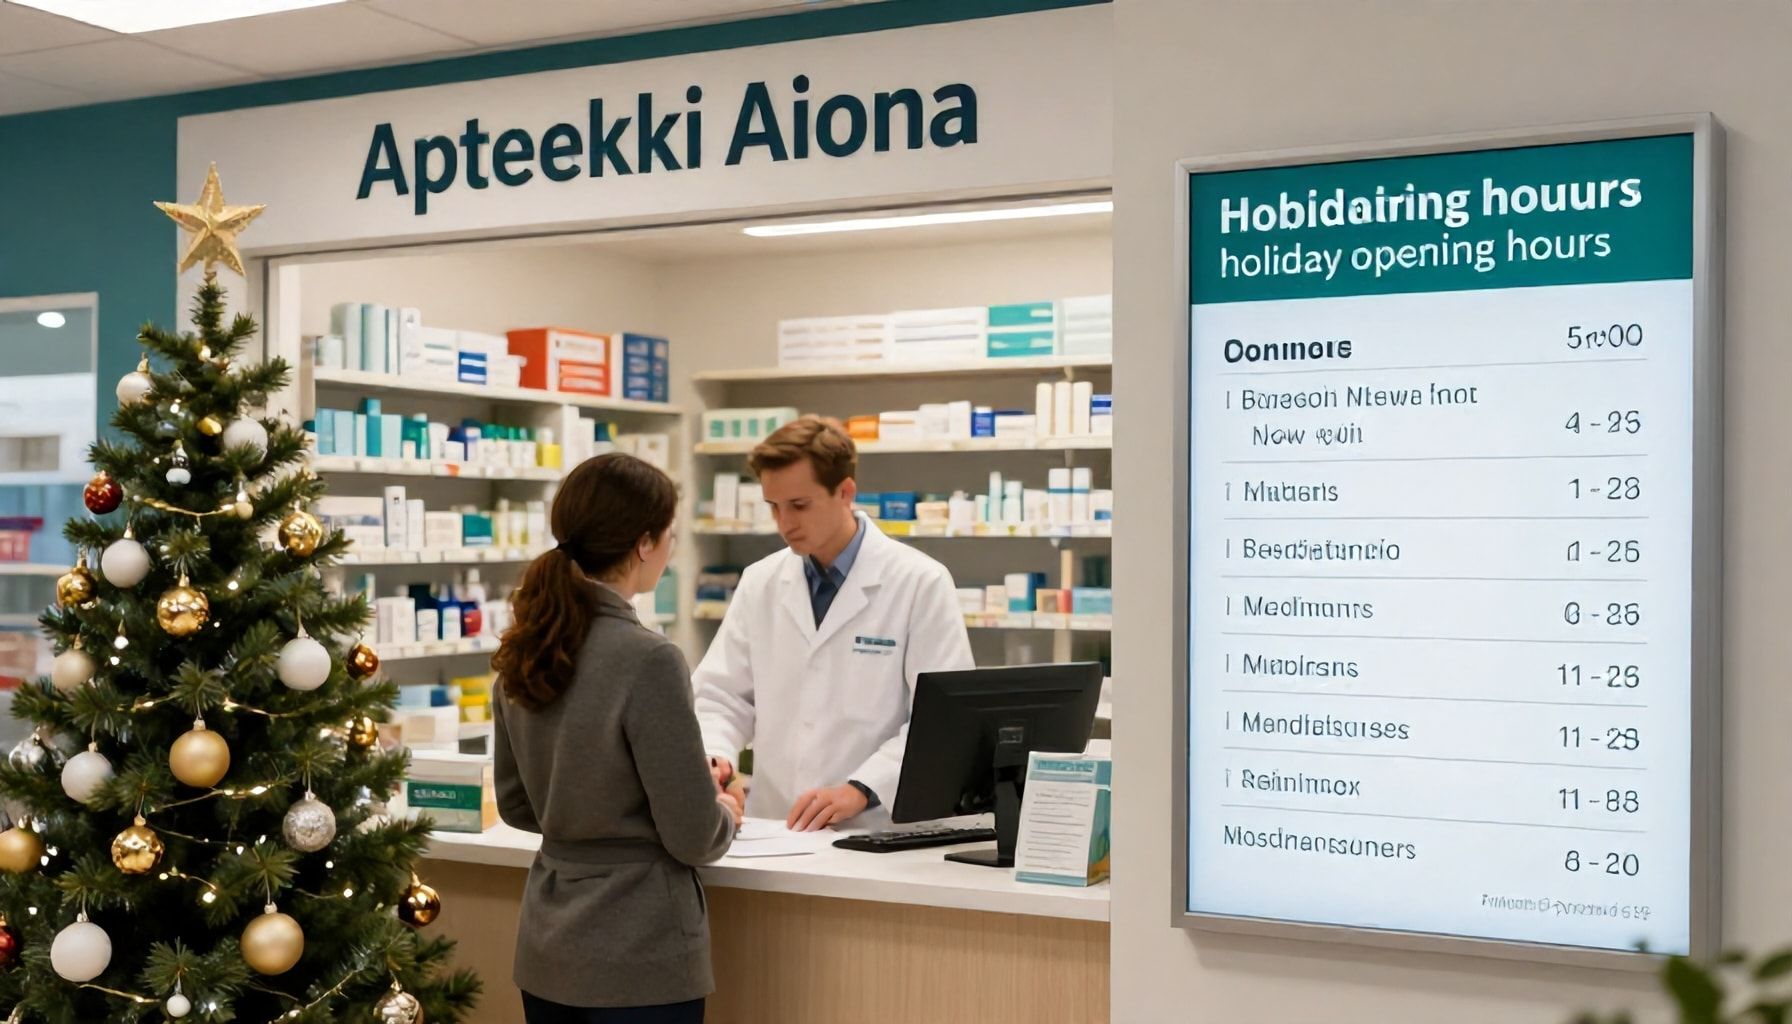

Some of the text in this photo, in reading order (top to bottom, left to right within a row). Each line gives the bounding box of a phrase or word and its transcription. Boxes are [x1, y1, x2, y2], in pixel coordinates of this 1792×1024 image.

[355, 74, 978, 216] Apteekki Aiona
[1483, 178, 1642, 216] houurs
[1221, 228, 1612, 281] holiday opening hours
[1557, 663, 1581, 687] 11
[1559, 726, 1581, 748] 11
[1606, 852, 1640, 877] 20
